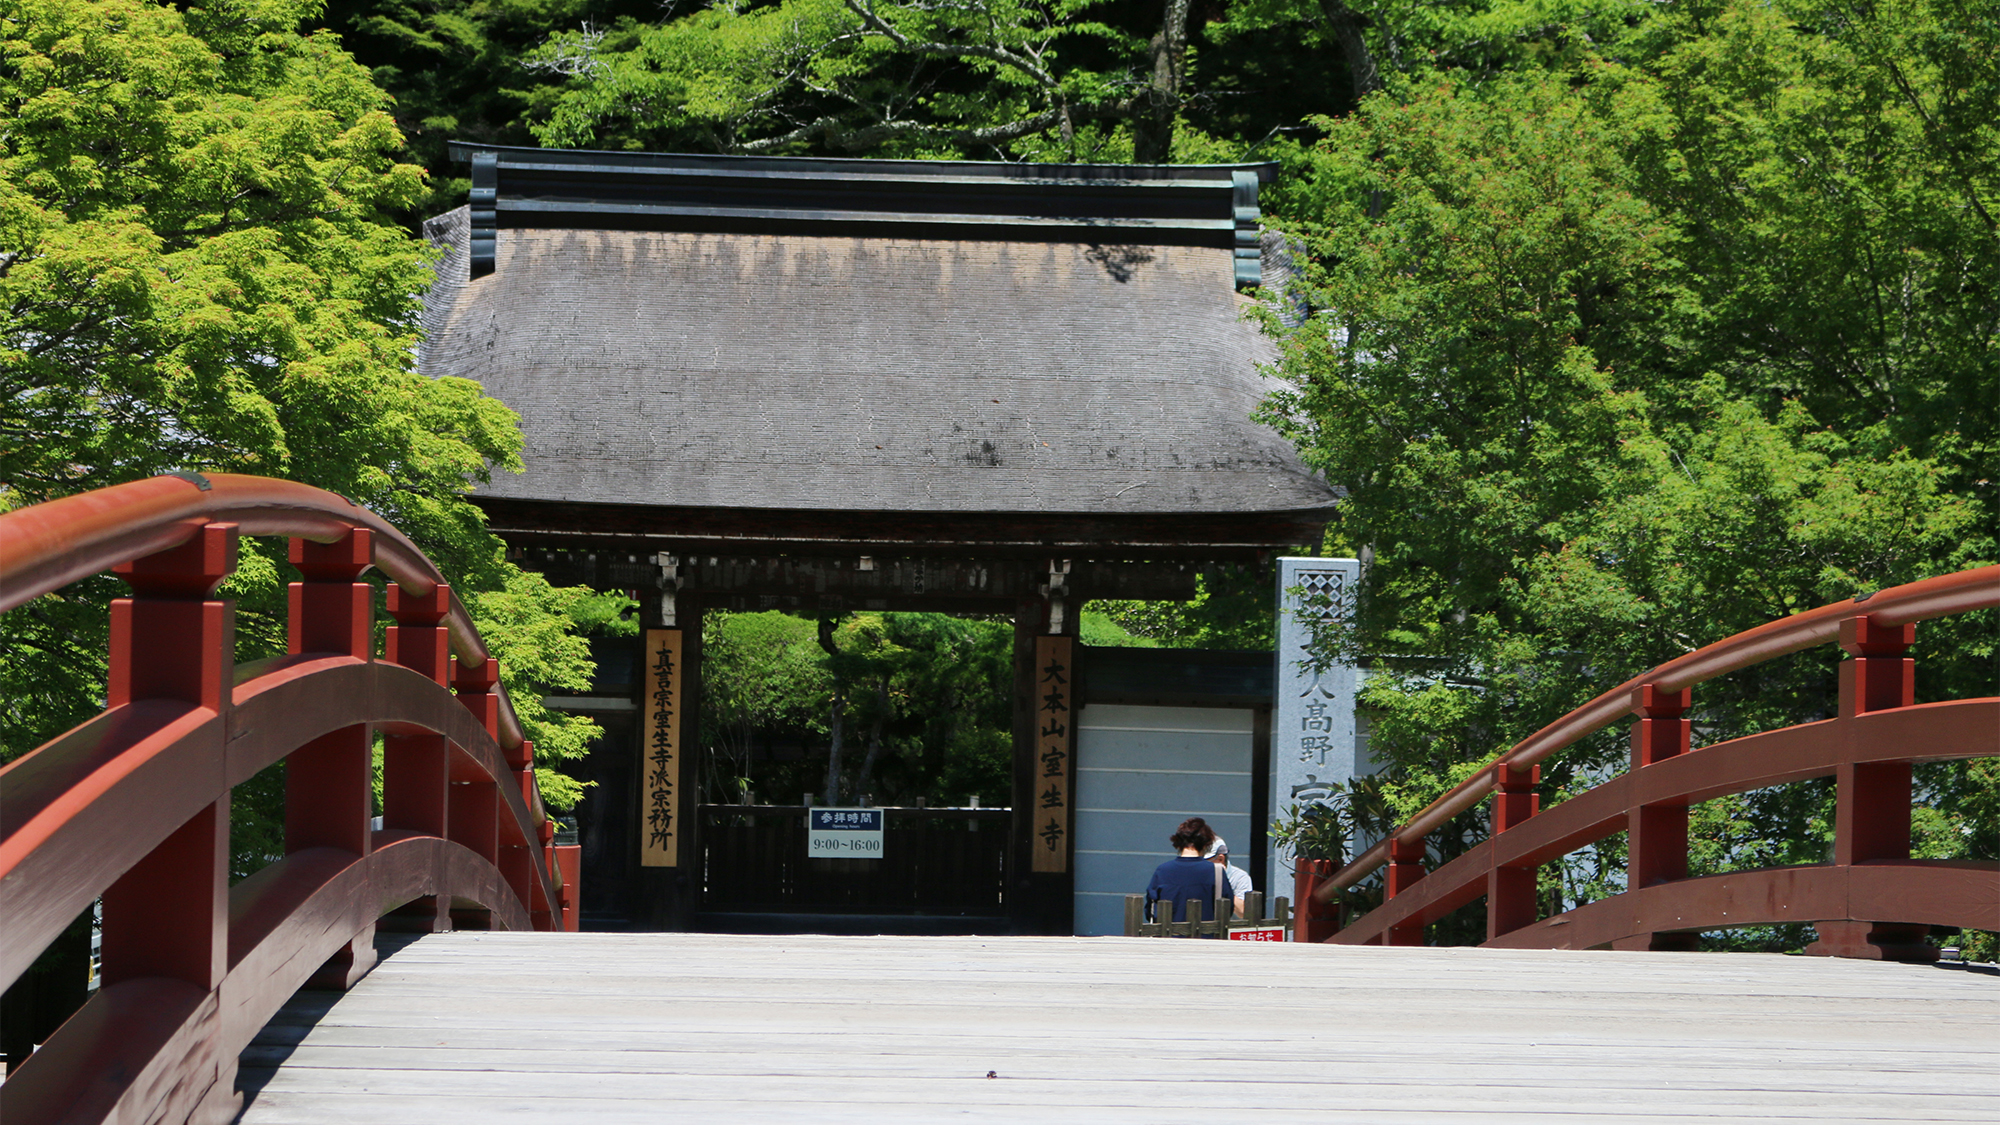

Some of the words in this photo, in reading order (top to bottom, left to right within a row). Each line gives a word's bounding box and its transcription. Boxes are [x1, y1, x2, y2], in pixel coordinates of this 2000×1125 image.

[647, 648, 675, 851] 真言宗室生寺派宗務所
[1039, 659, 1069, 851] 大本山室生寺
[820, 812, 872, 824] 参拝時間
[1239, 932, 1274, 942] お知らせ
